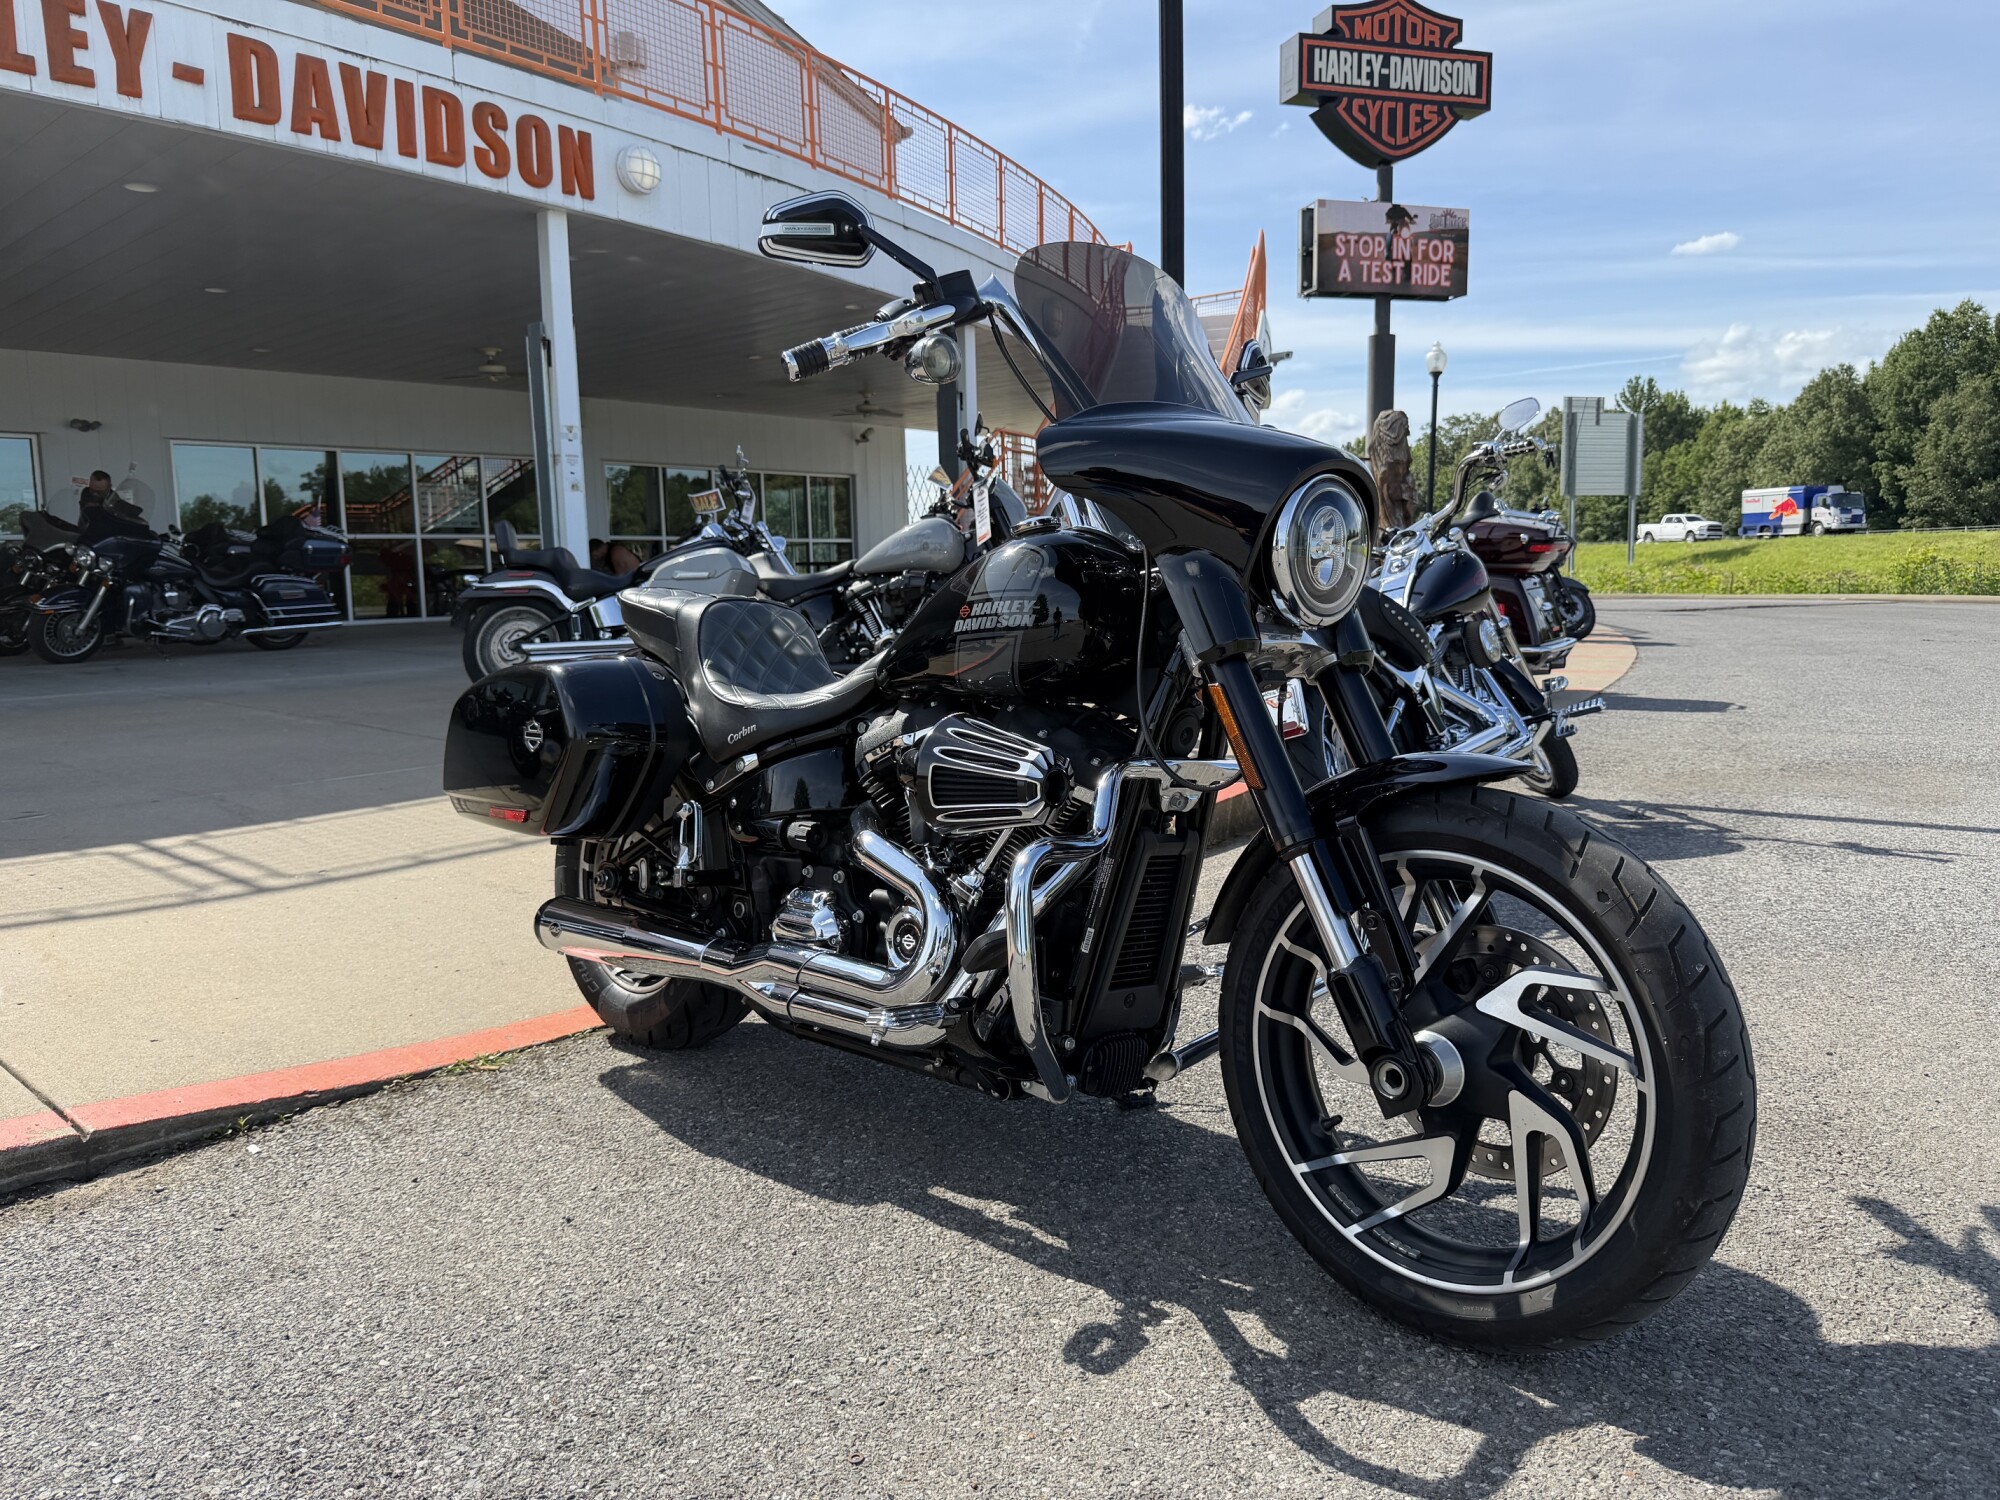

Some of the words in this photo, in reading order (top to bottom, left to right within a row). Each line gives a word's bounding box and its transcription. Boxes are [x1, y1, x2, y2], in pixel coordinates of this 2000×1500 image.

[1354, 6, 1441, 48] MOTOR
[1313, 47, 1477, 97] HARLEY-DAVIDSON
[1352, 98, 1438, 146] CYCLES
[1335, 234, 1386, 258] STOP
[1392, 237, 1411, 260] IN
[1417, 239, 1455, 263] FOR
[1338, 260, 1351, 282] A
[1360, 261, 1405, 285] TEST
[1411, 263, 1452, 287] RIDE
[954, 614, 1036, 633] DAVIDSON
[728, 724, 757, 745] Corbin
